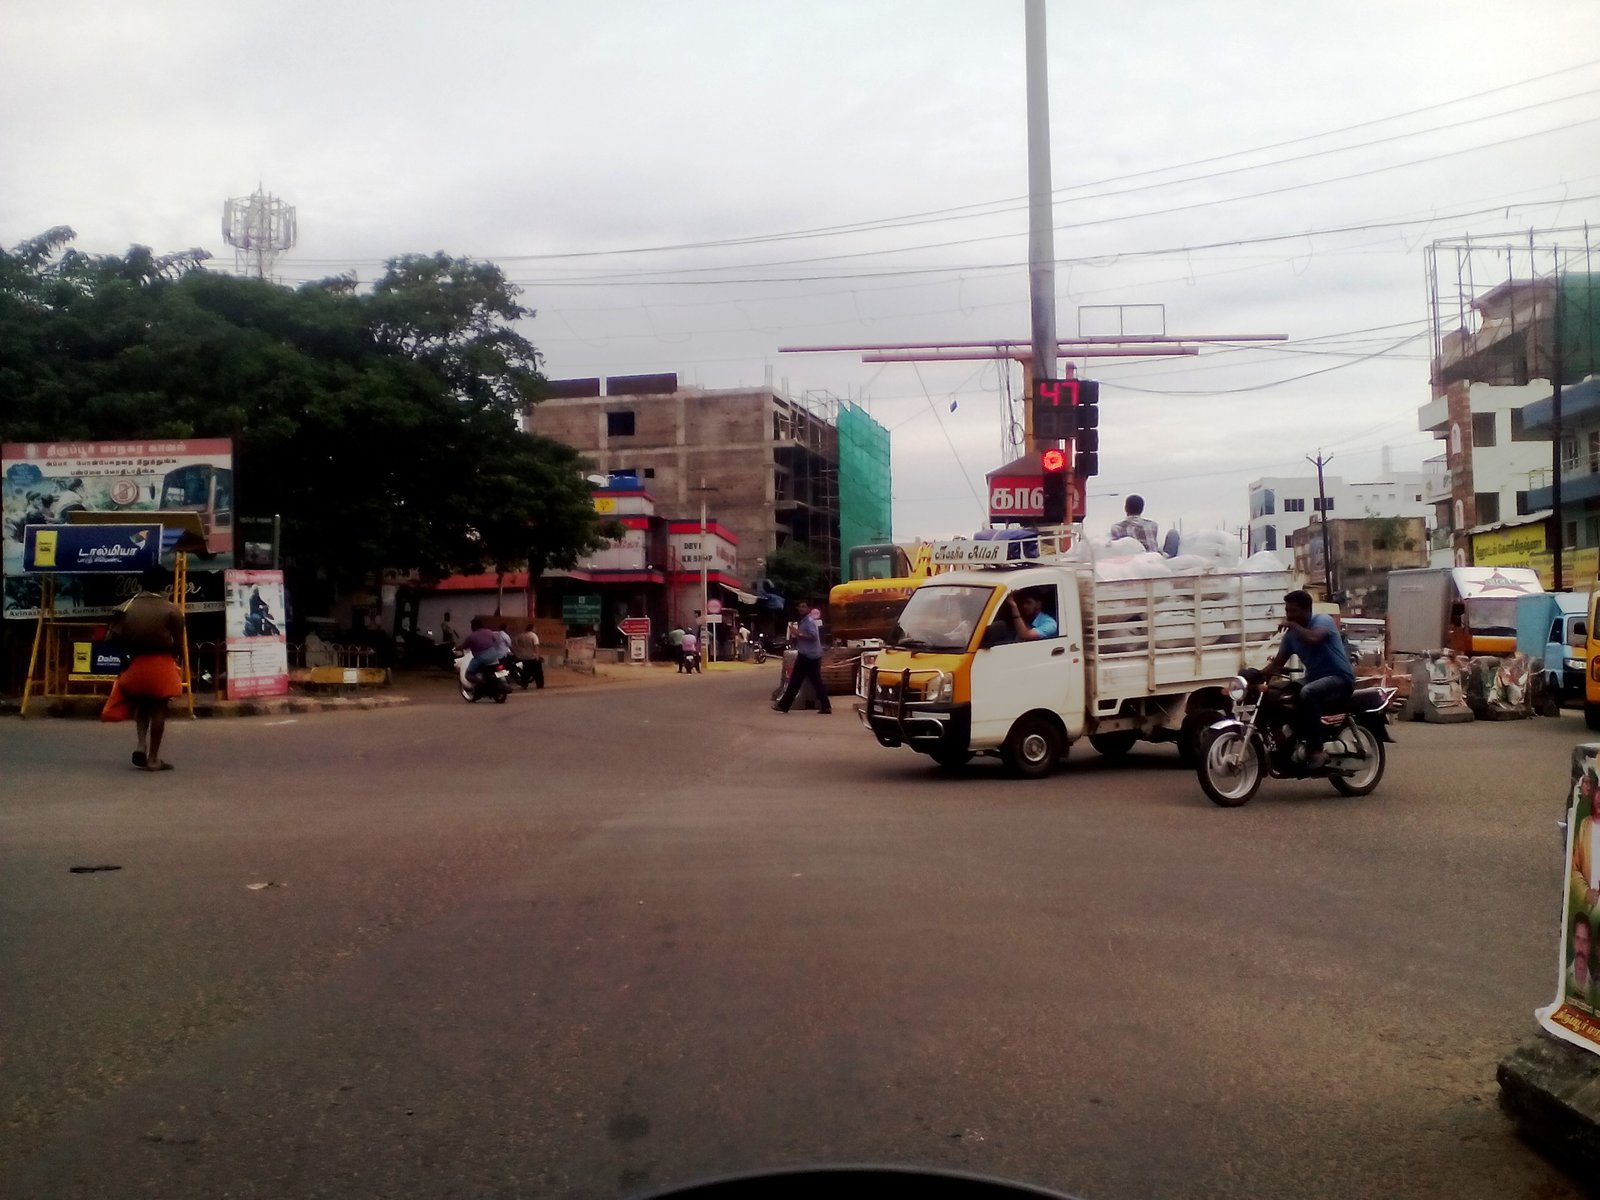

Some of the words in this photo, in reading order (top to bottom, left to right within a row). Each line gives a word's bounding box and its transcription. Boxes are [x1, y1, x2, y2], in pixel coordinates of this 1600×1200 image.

[1040, 381, 1080, 406] 47
[78, 544, 137, 556] டால்மியா
[967, 545, 1000, 560] Allah
